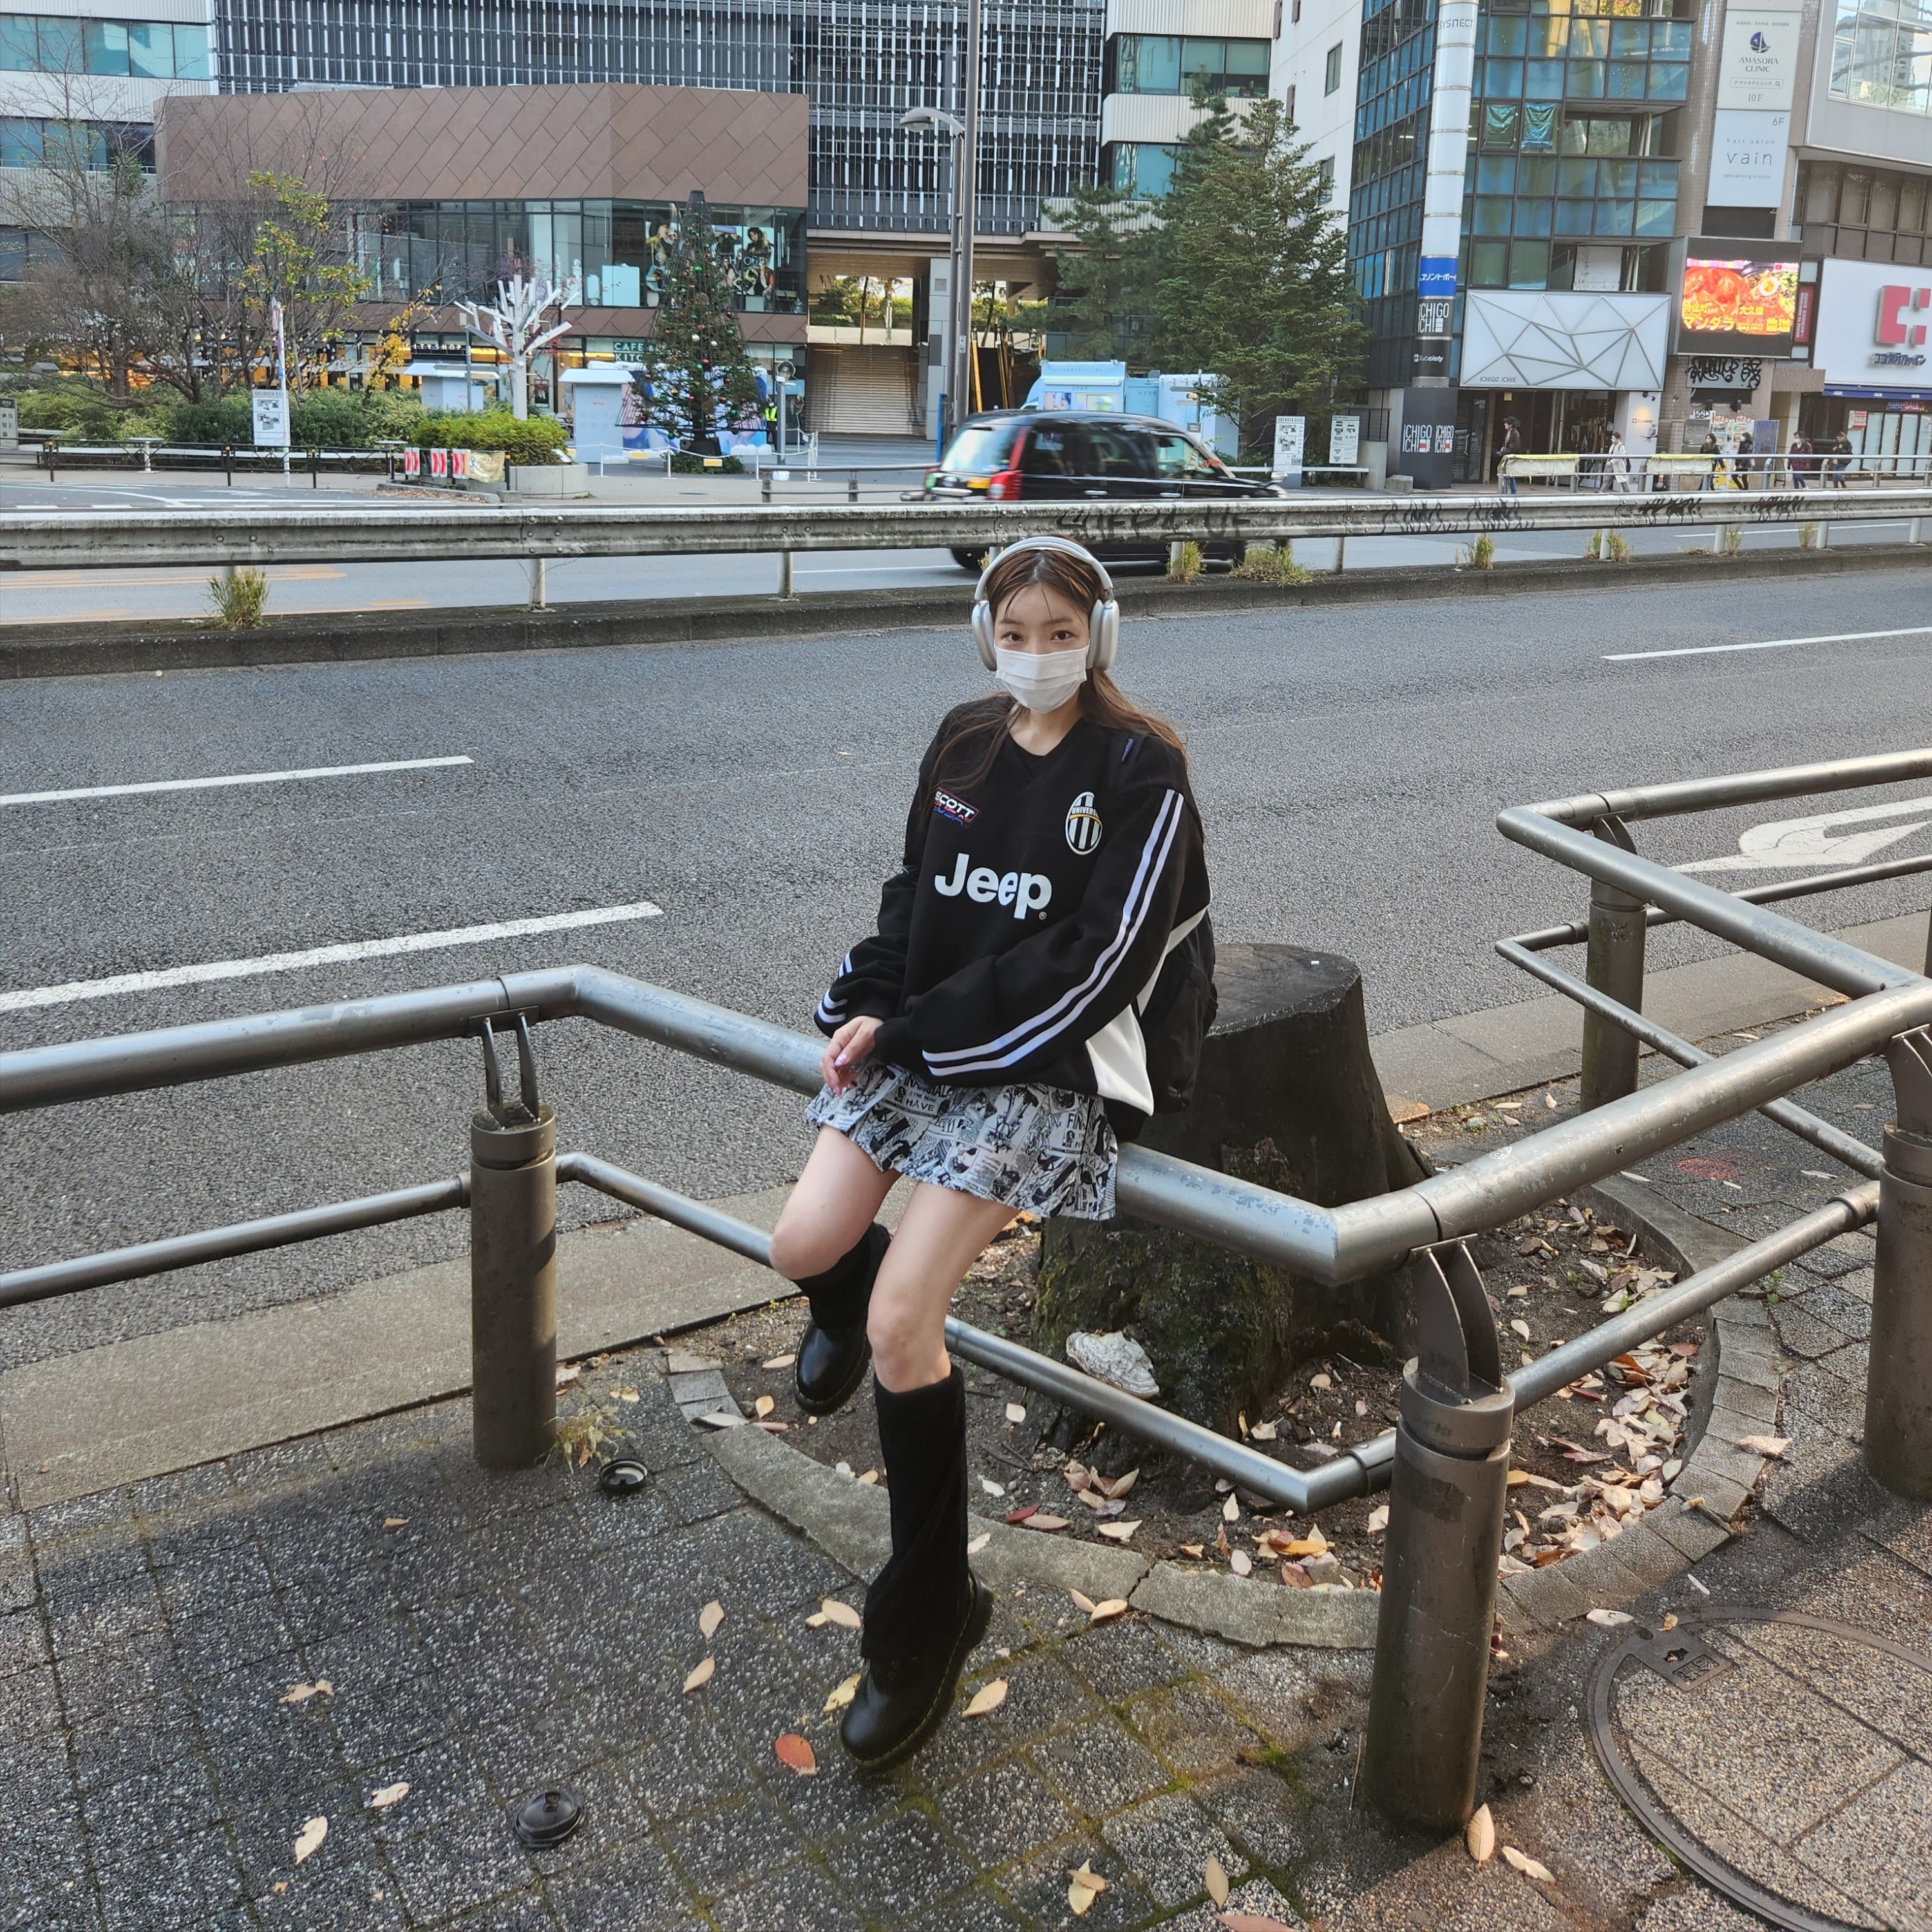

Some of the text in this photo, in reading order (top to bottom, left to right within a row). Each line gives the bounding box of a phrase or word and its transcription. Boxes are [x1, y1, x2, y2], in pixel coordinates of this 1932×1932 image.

[1772, 117, 1785, 126] 6F
[1727, 153, 1772, 165] vain
[1683, 315, 1735, 331] マンダラ
[614, 342, 644, 351] CAFE
[935, 791, 975, 818] SCOTT
[934, 853, 1052, 920] Jeep
